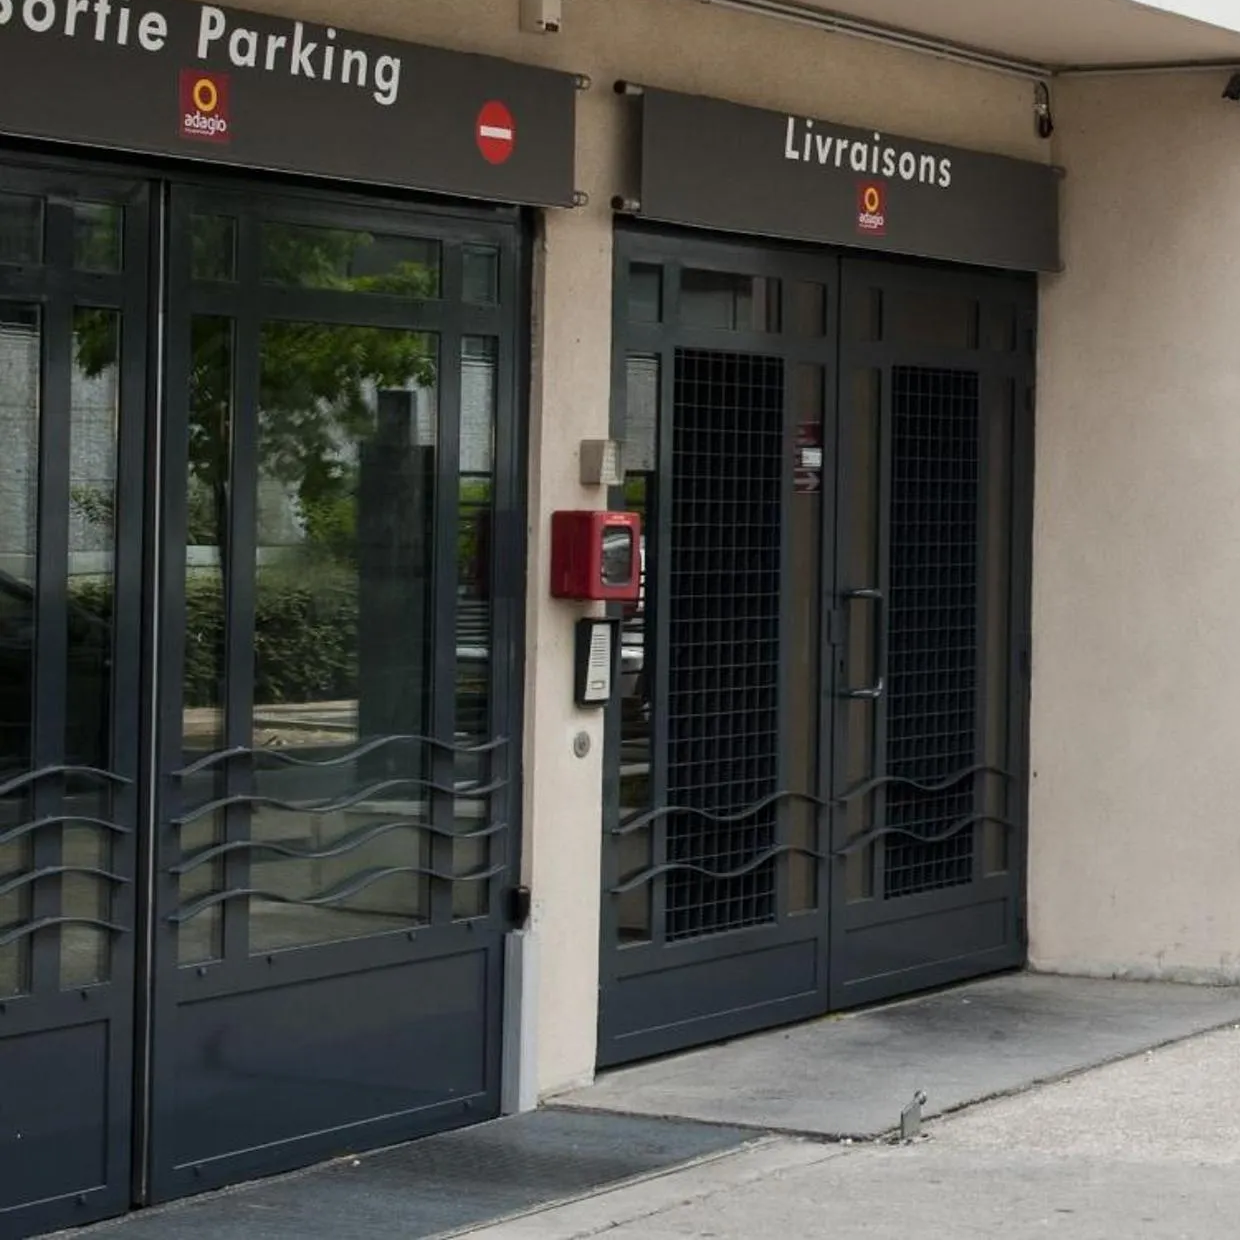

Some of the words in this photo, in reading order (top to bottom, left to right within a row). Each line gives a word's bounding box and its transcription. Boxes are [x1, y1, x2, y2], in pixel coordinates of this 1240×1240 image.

[197, 5, 402, 106] Parking
[184, 110, 227, 136] adagio
[784, 116, 952, 188] Livraisons
